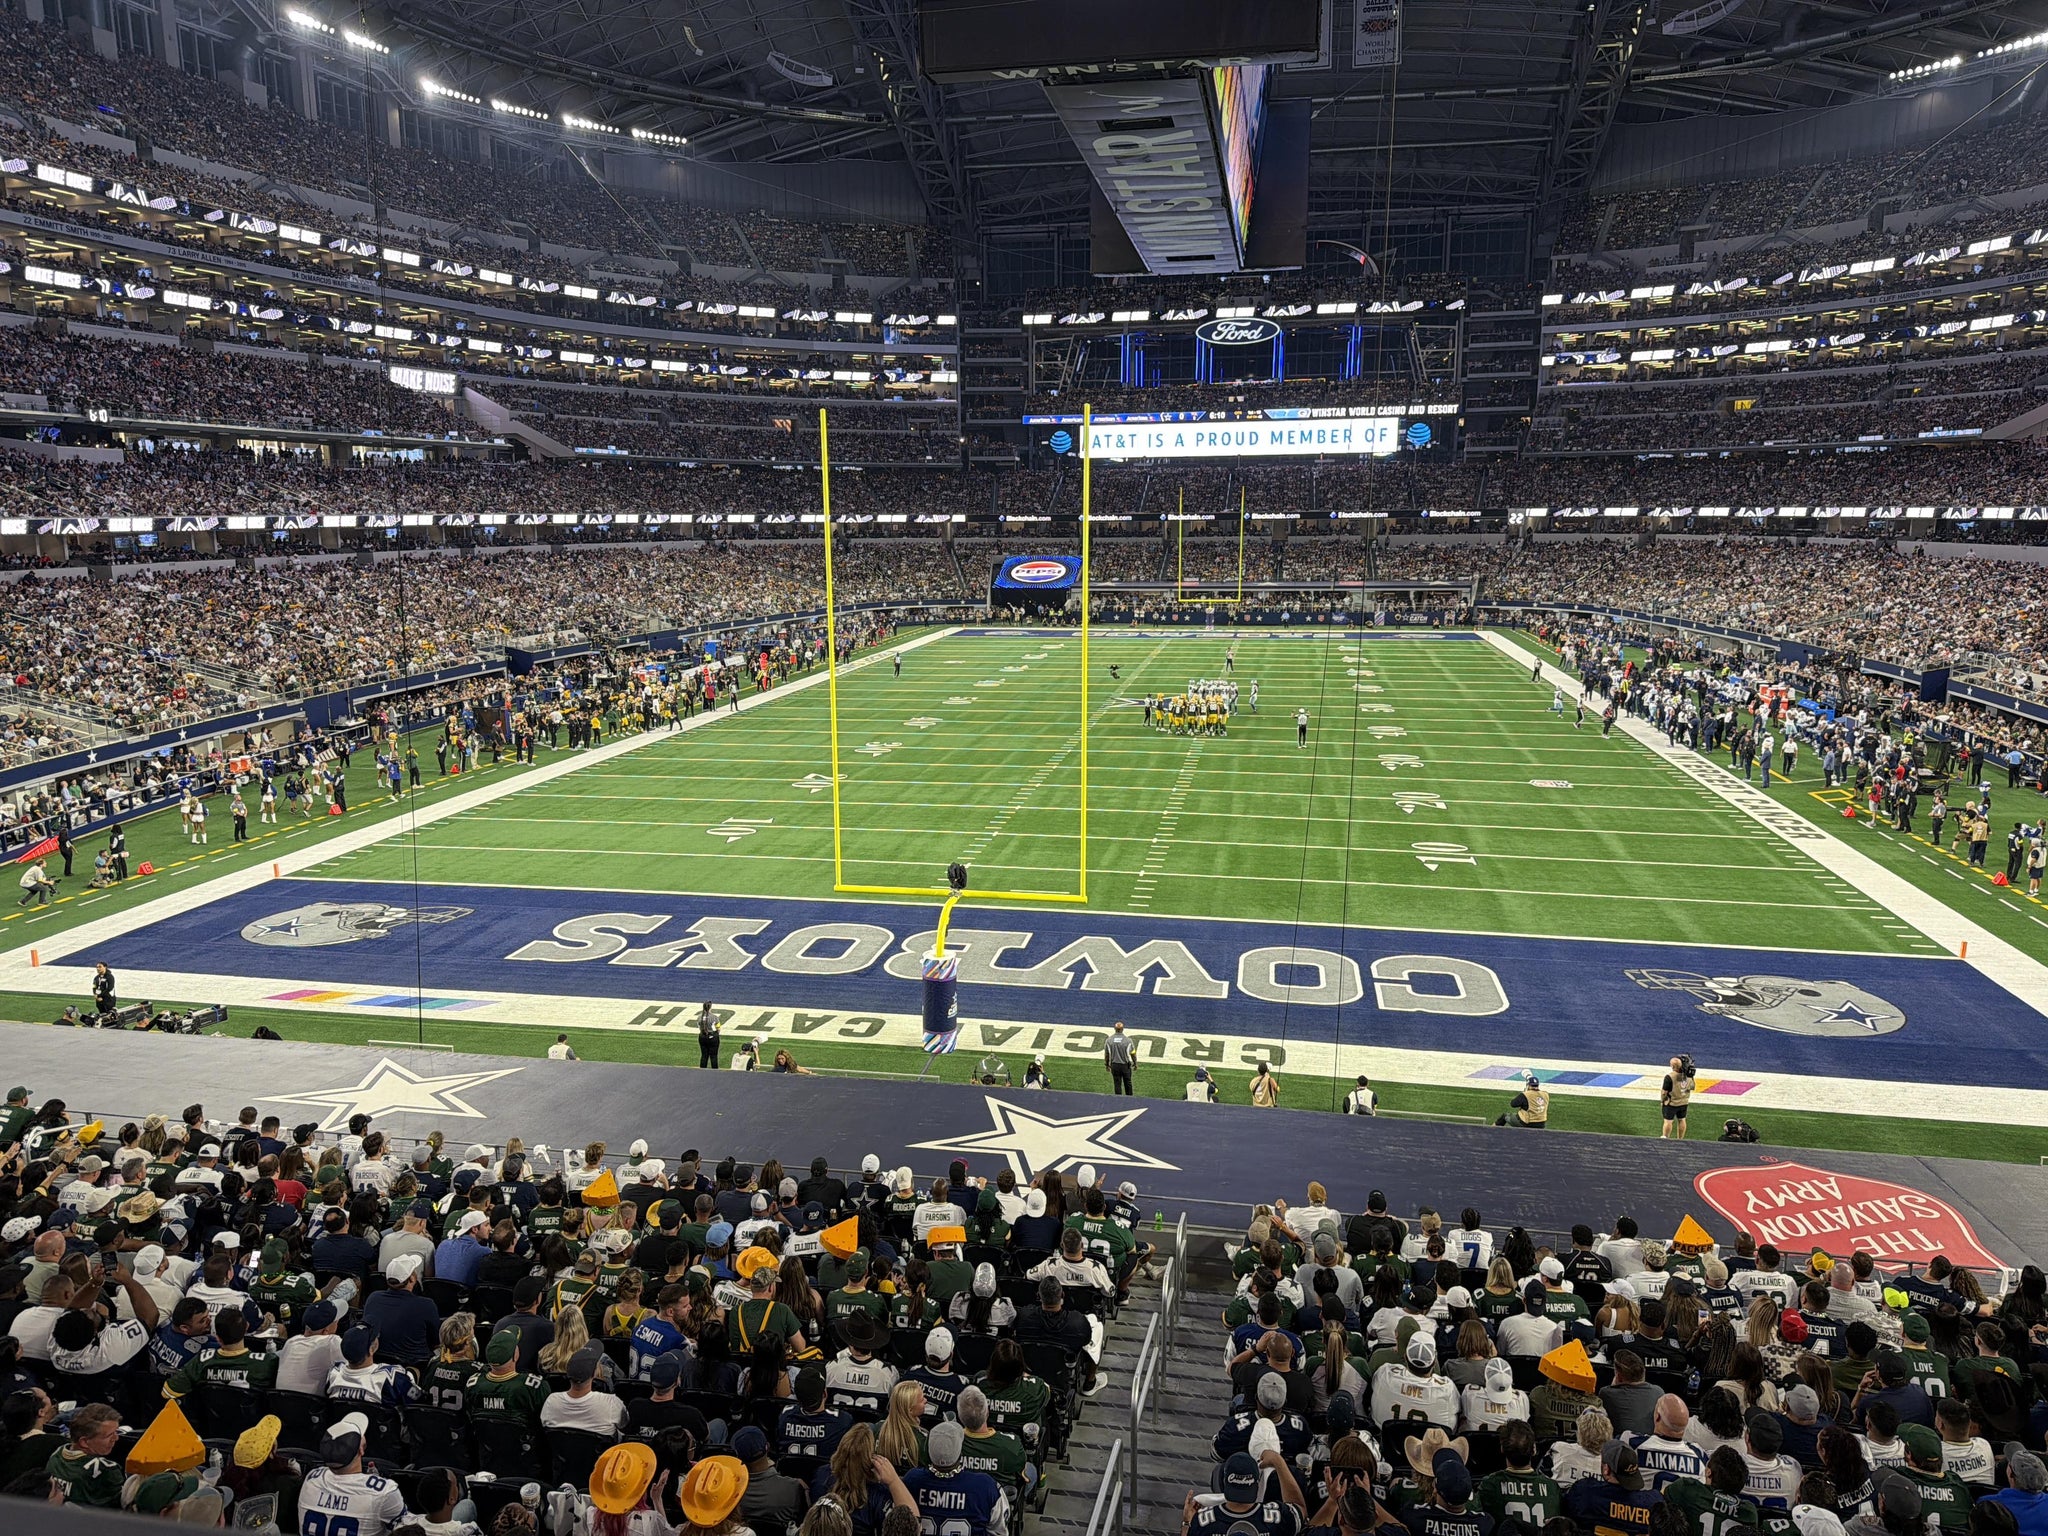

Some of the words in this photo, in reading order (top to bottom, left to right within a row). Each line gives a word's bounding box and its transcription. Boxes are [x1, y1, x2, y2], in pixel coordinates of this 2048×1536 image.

[991, 57, 1252, 80] WINSTAR
[1092, 129, 1225, 268] WINSTAR
[34, 219, 65, 233] EMMITT
[66, 224, 90, 237] SMITH
[167, 247, 176, 255] 73
[178, 249, 200, 260] LARRY
[201, 255, 222, 264] ALLEN
[1758, 307, 1783, 316] WRIGHT
[1212, 321, 1264, 340] Ford
[390, 366, 423, 391] MAKE
[424, 370, 456, 394] NOISE
[1209, 412, 1227, 420] 6:10
[1312, 408, 1346, 418] WINSTAR
[1349, 406, 1375, 417] WORLD
[1378, 406, 1405, 416] CASINO
[1408, 405, 1425, 415] AND
[1428, 404, 1459, 414] RESORT
[1092, 434, 1137, 449] AT&T
[1148, 433, 1163, 448] IS
[1175, 432, 1185, 447] A
[1196, 431, 1259, 447] PROUD
[1271, 429, 1352, 445] MEMBER
[1364, 428, 1388, 443] OF
[1429, 509, 1481, 517] Blockchain.com
[1508, 512, 1524, 525] 22
[1392, 791, 1448, 811] 20
[1663, 752, 1758, 796] INTERCEPT
[1733, 798, 1827, 841] CANCER
[706, 816, 774, 837] 10
[1411, 842, 1478, 867] 10
[505, 912, 1510, 1016] COWBOYS
[628, 1005, 887, 1039] CATCH
[355, 1171, 379, 1180] PARSONS
[1743, 1177, 1844, 1215] ARMY
[893, 1203, 916, 1213] RODGERS
[1114, 1205, 1131, 1218] SMITH
[534, 1215, 560, 1226] RODGERS
[925, 1213, 951, 1222] PARSONS
[1750, 1194, 1942, 1246] SALVATION
[1083, 1222, 1104, 1233] WHITE
[1461, 1233, 1482, 1241] DIGGS
[1851, 1228, 1946, 1258] THE
[795, 1241, 818, 1251] ELLIOTT
[1463, 1242, 1480, 1269] 7
[1066, 1273, 1084, 1282] LAMB
[1749, 1277, 1786, 1288] ALEXANDER
[1711, 1297, 1735, 1308] WITTEN
[1909, 1291, 1940, 1307] PICKENS
[1491, 1305, 1510, 1314] LOVE
[1545, 1303, 1576, 1313] PARSONS
[1807, 1326, 1837, 1337] RESCOTT
[149, 1336, 183, 1362] PEARSON
[1811, 1339, 1831, 1356] 4
[1644, 1357, 1669, 1368] LAMB
[1913, 1362, 1935, 1374] LOVE
[207, 1369, 248, 1382] McKINNEY
[434, 1368, 461, 1380] RODGERS
[846, 1372, 870, 1386] LAMB
[429, 1386, 463, 1410] 12
[1400, 1384, 1423, 1399] LOVE
[986, 1399, 1022, 1414] PARSONS
[1484, 1403, 1508, 1414] LOVE
[785, 1423, 826, 1438] PARSONS
[83, 1457, 118, 1479] 70
[1645, 1452, 1695, 1474] AIKMAN
[1948, 1454, 1987, 1473] PARSONS
[1500, 1481, 1534, 1497] WOLFE
[1538, 1483, 1547, 1497] IV
[1745, 1477, 1782, 1489] WITTEN
[318, 1492, 349, 1511] LAMB
[1917, 1486, 1955, 1502] ARSONS
[1609, 1502, 1650, 1526] DRIVER
[1425, 1517, 1480, 1536] PARSONS
